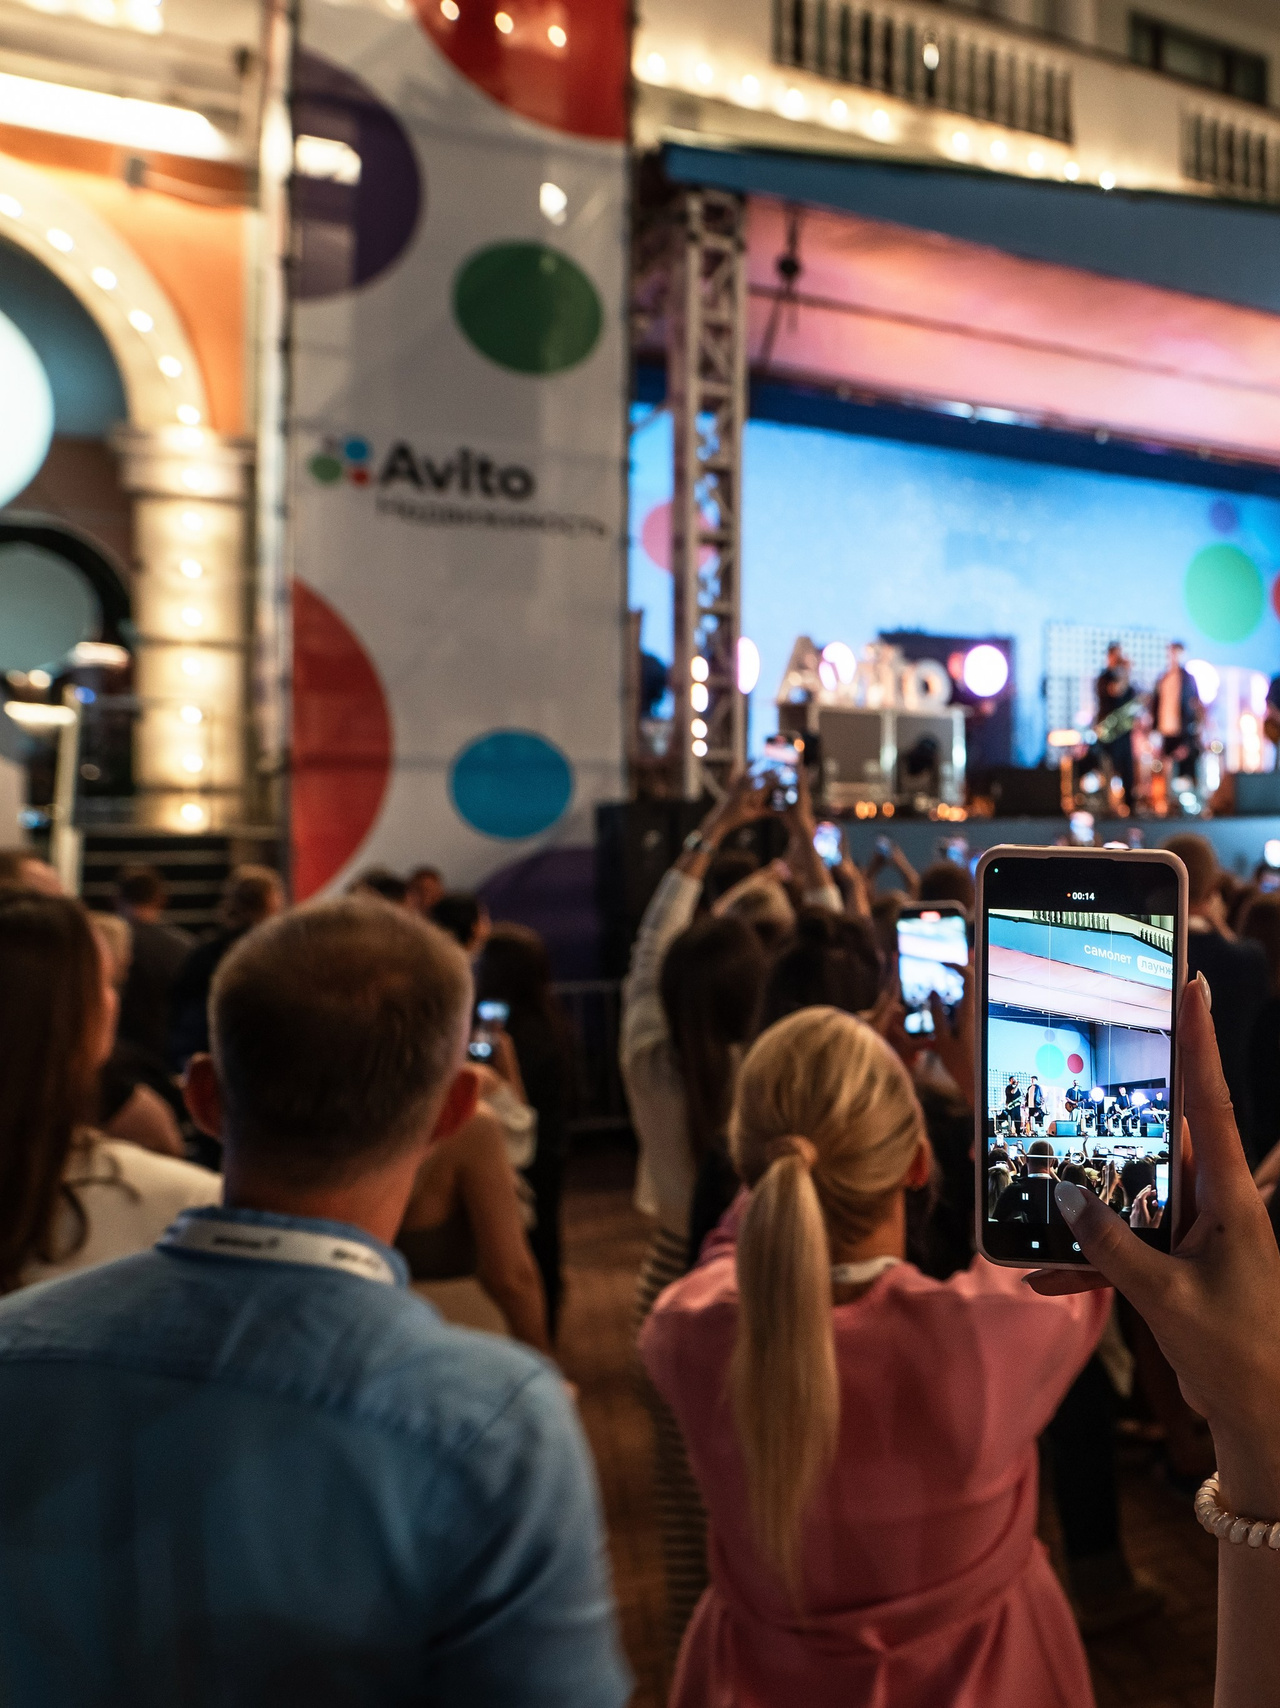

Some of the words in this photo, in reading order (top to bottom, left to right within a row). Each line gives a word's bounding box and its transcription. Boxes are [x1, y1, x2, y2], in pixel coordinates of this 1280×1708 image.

[380, 439, 537, 501] Avito
[1072, 892, 1095, 900] 00:14
[1084, 944, 1132, 965] самолет
